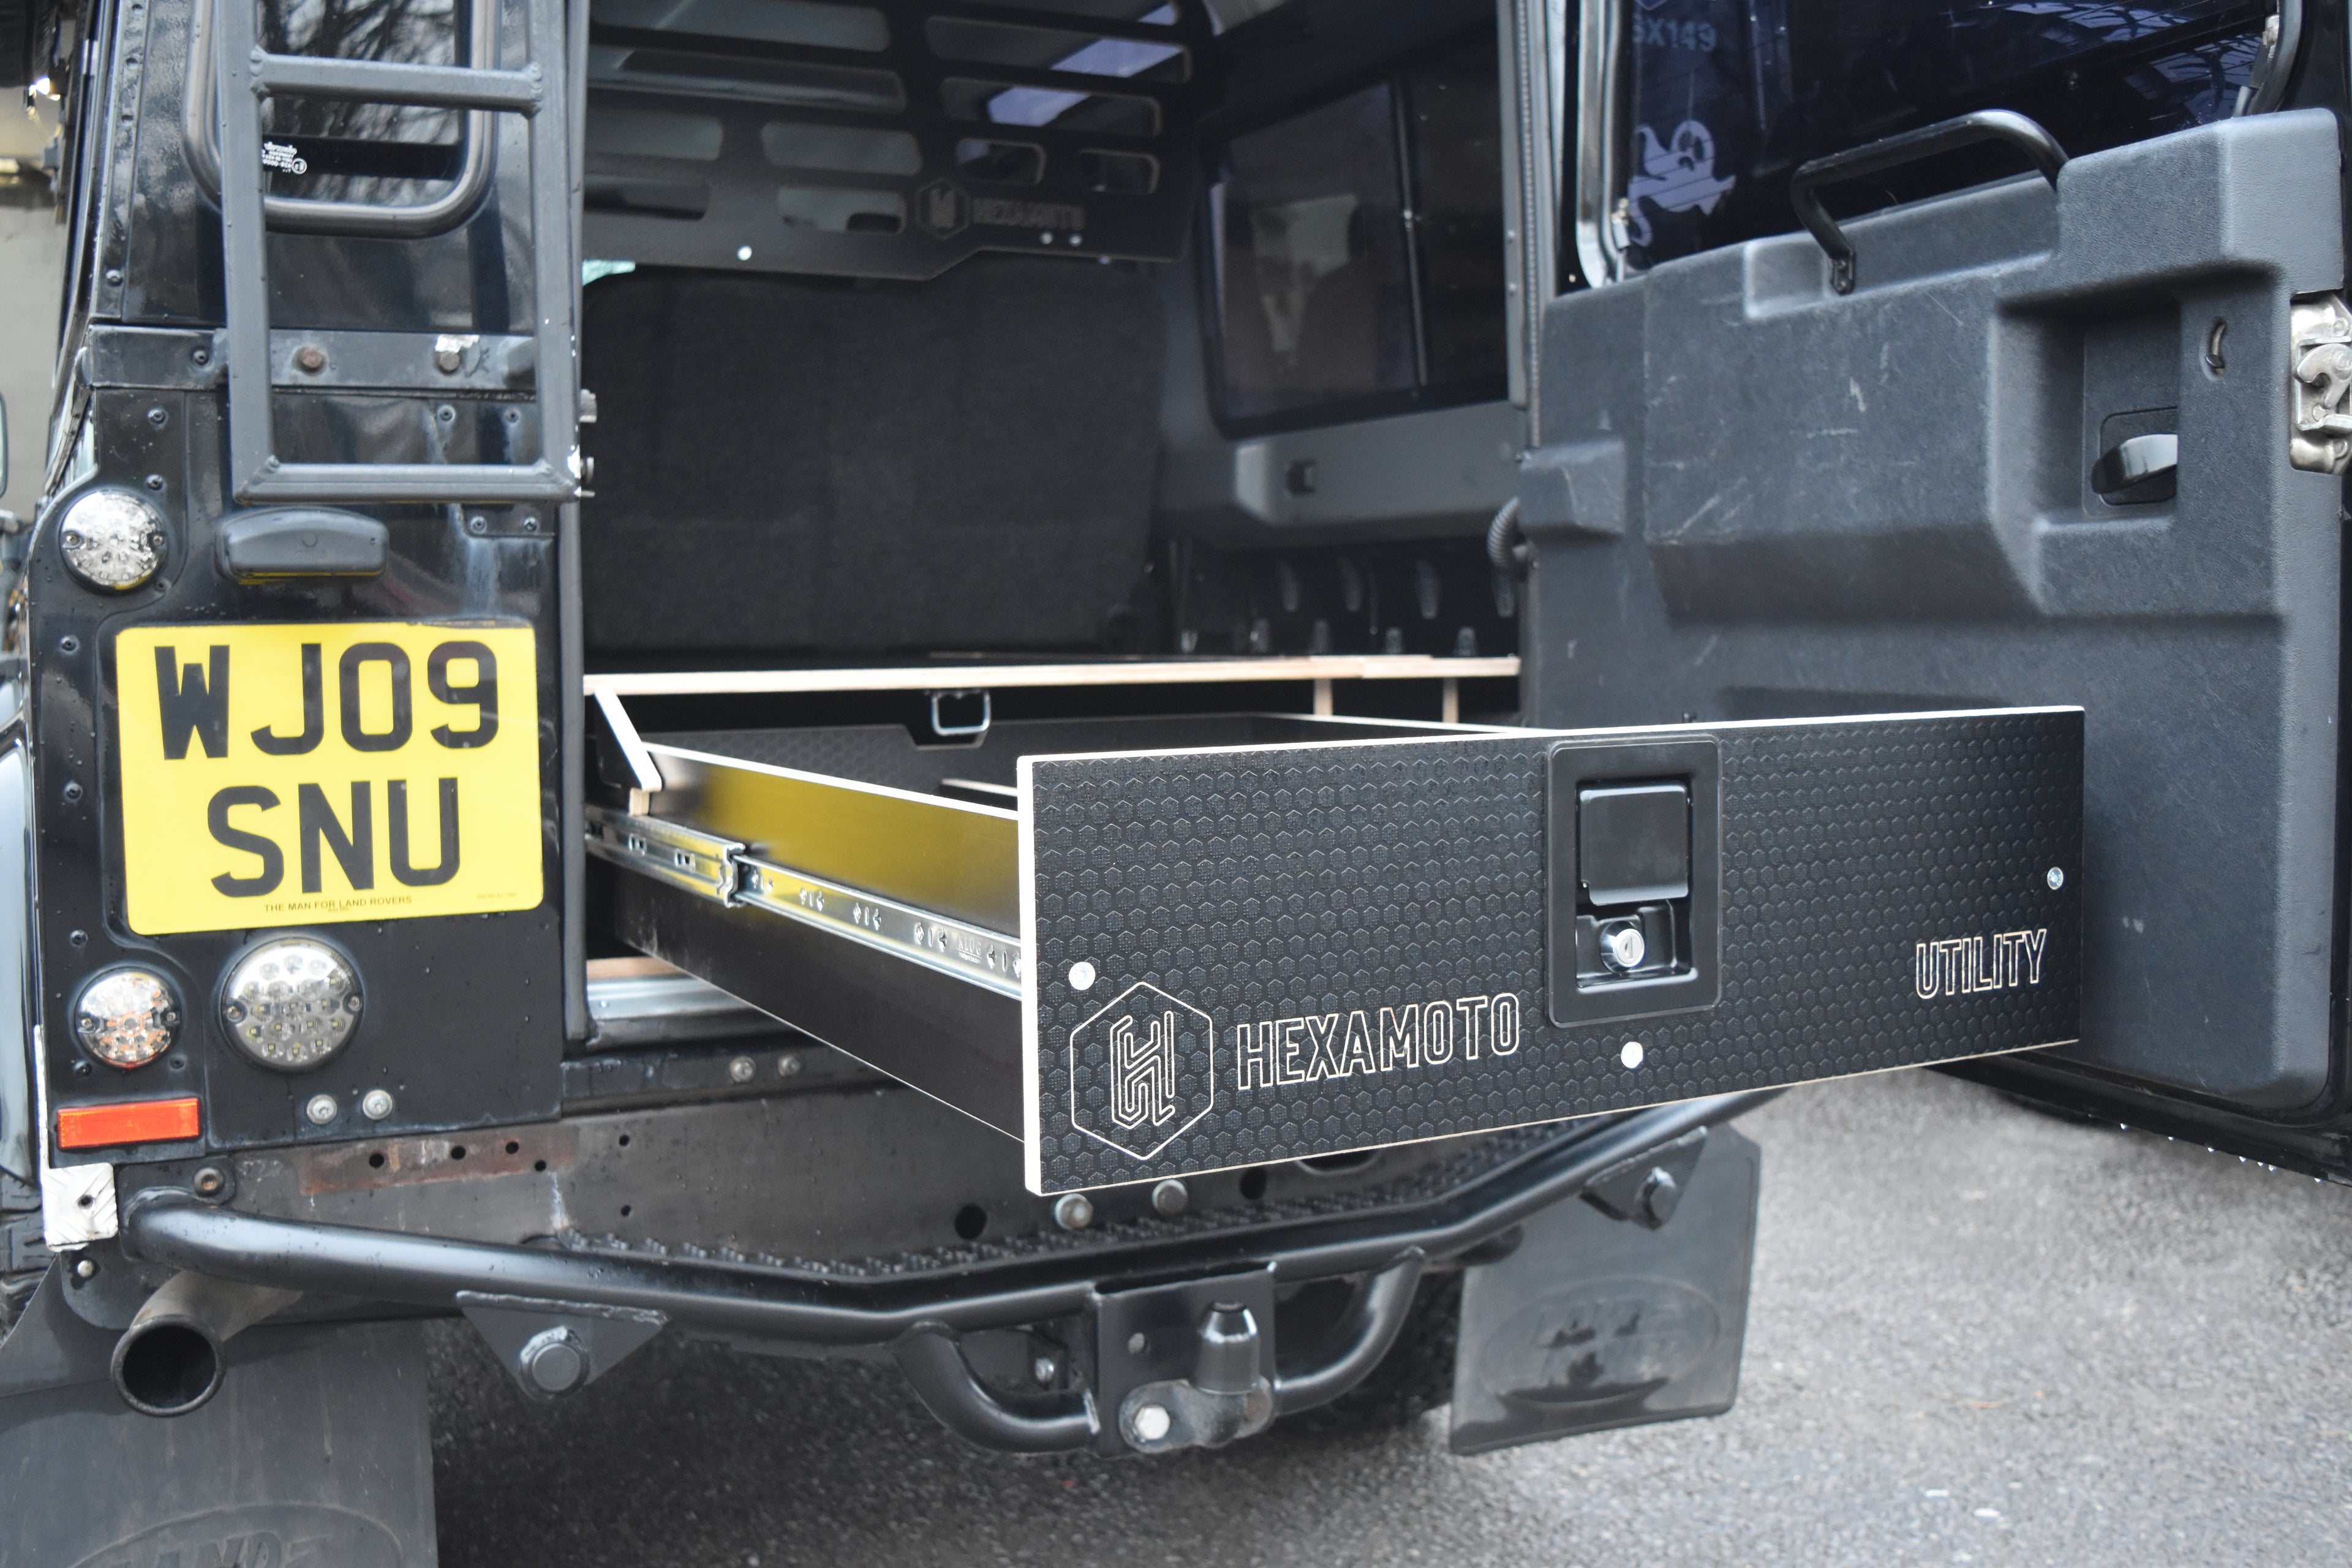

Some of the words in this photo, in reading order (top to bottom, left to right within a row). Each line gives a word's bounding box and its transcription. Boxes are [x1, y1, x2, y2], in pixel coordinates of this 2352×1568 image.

[154, 640, 499, 761] WJ09
[207, 777, 461, 899] SNU
[265, 903, 284, 913] THE
[288, 900, 311, 911] MAN
[314, 899, 336, 909] FOR
[339, 897, 367, 908] LAND
[370, 895, 412, 906] ROVERS
[1916, 929, 2047, 1000] UTILITY
[1237, 993, 1520, 1091] HEXAMOTO
